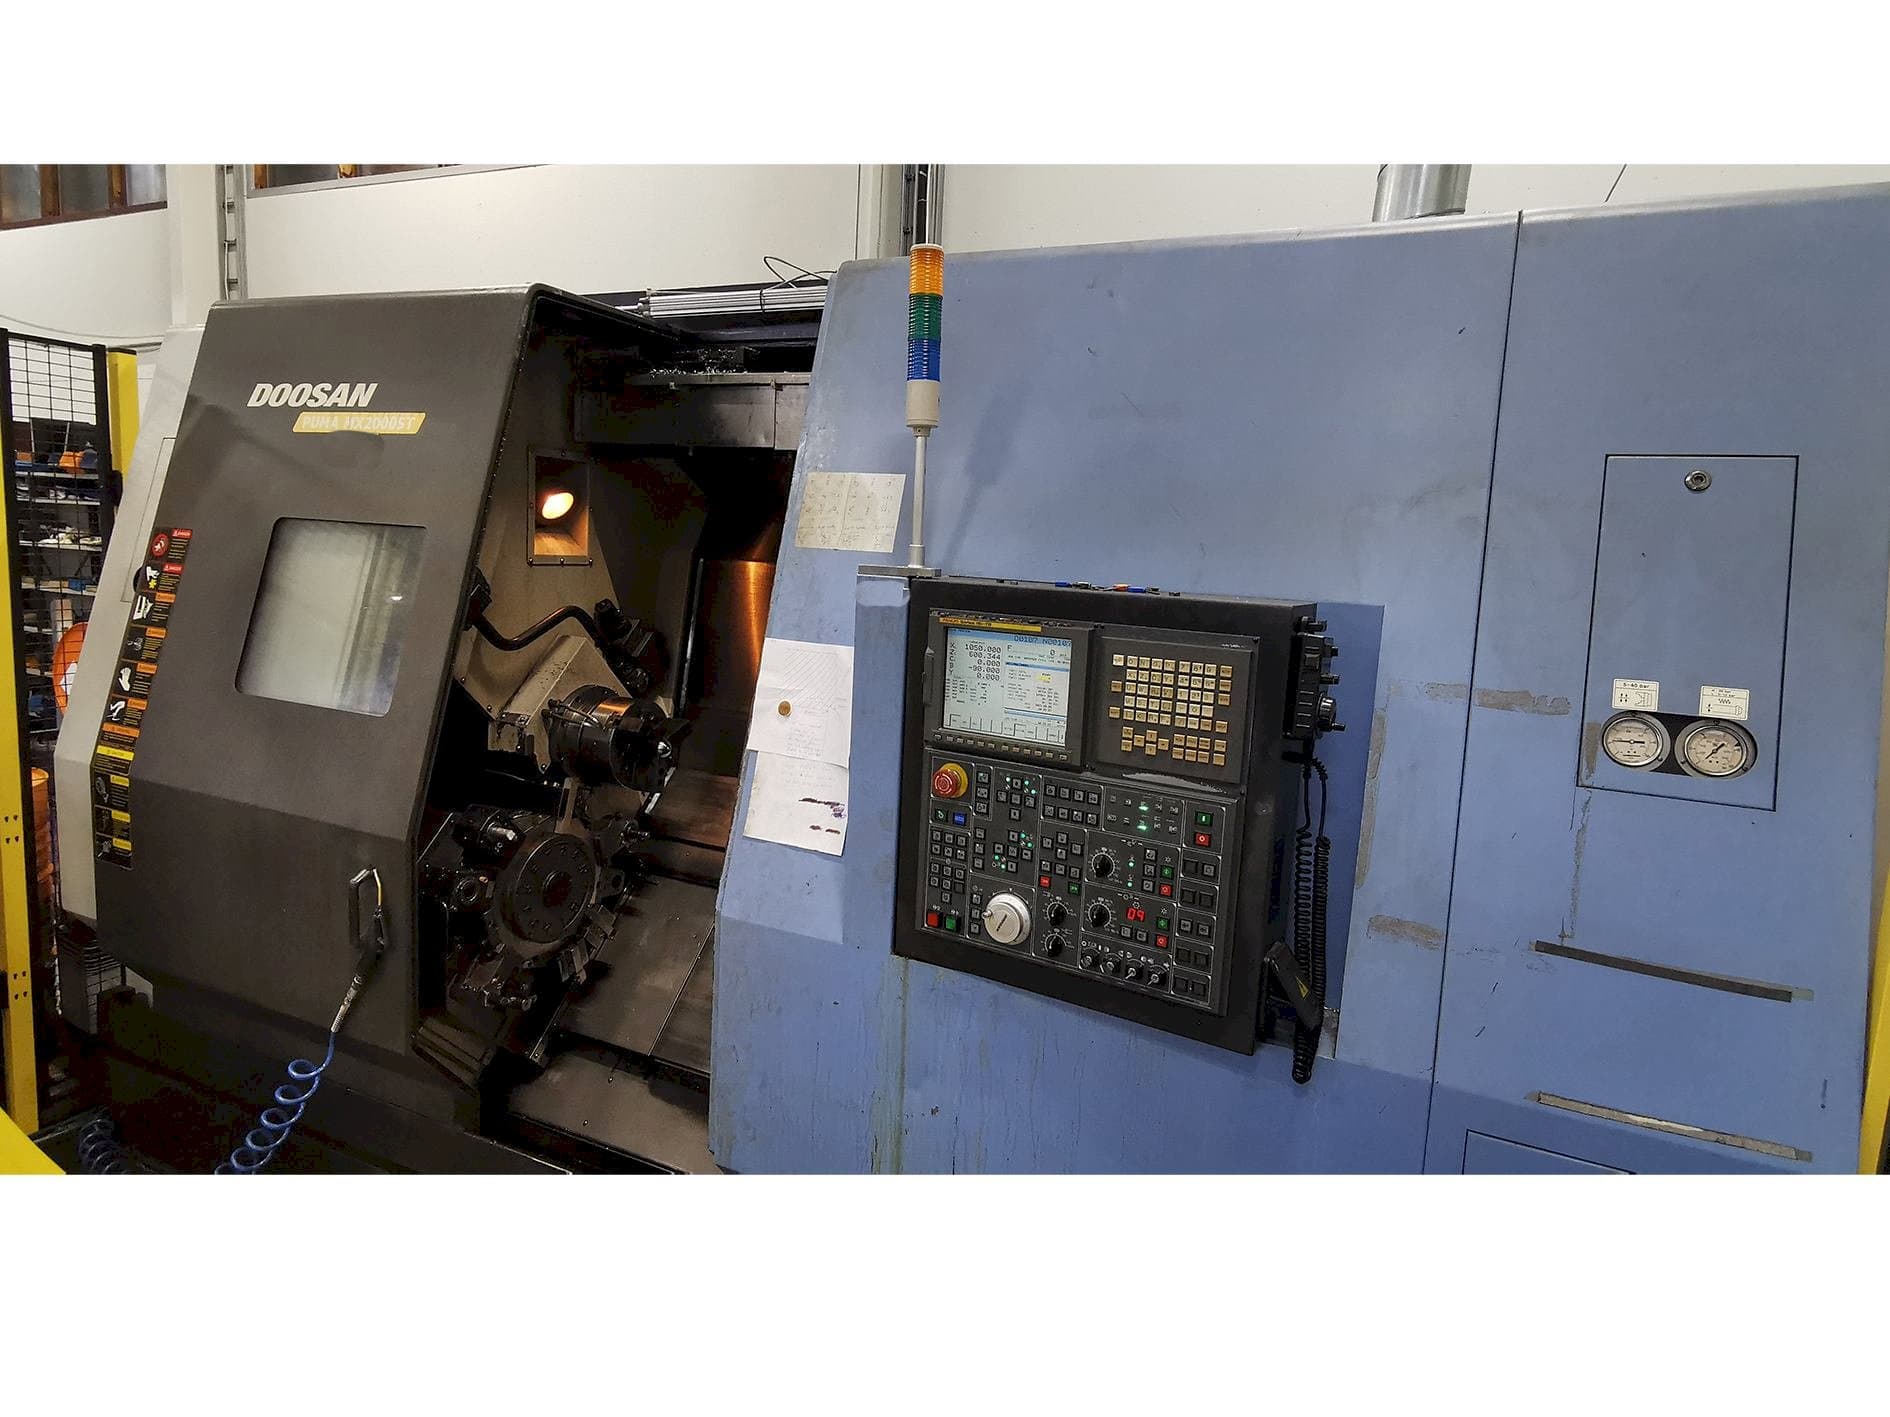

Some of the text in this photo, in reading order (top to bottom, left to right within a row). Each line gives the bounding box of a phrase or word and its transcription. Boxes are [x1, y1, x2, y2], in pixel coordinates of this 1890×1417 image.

[247, 383, 378, 407] DOOSAN
[303, 414, 417, 431] PUMA MX2000ST
[965, 643, 1002, 654] 1050.000
[969, 651, 1001, 660] 600.344
[977, 659, 1001, 667] 0.000
[976, 672, 1000, 681] 0.000
[1127, 907, 1145, 921] 09
